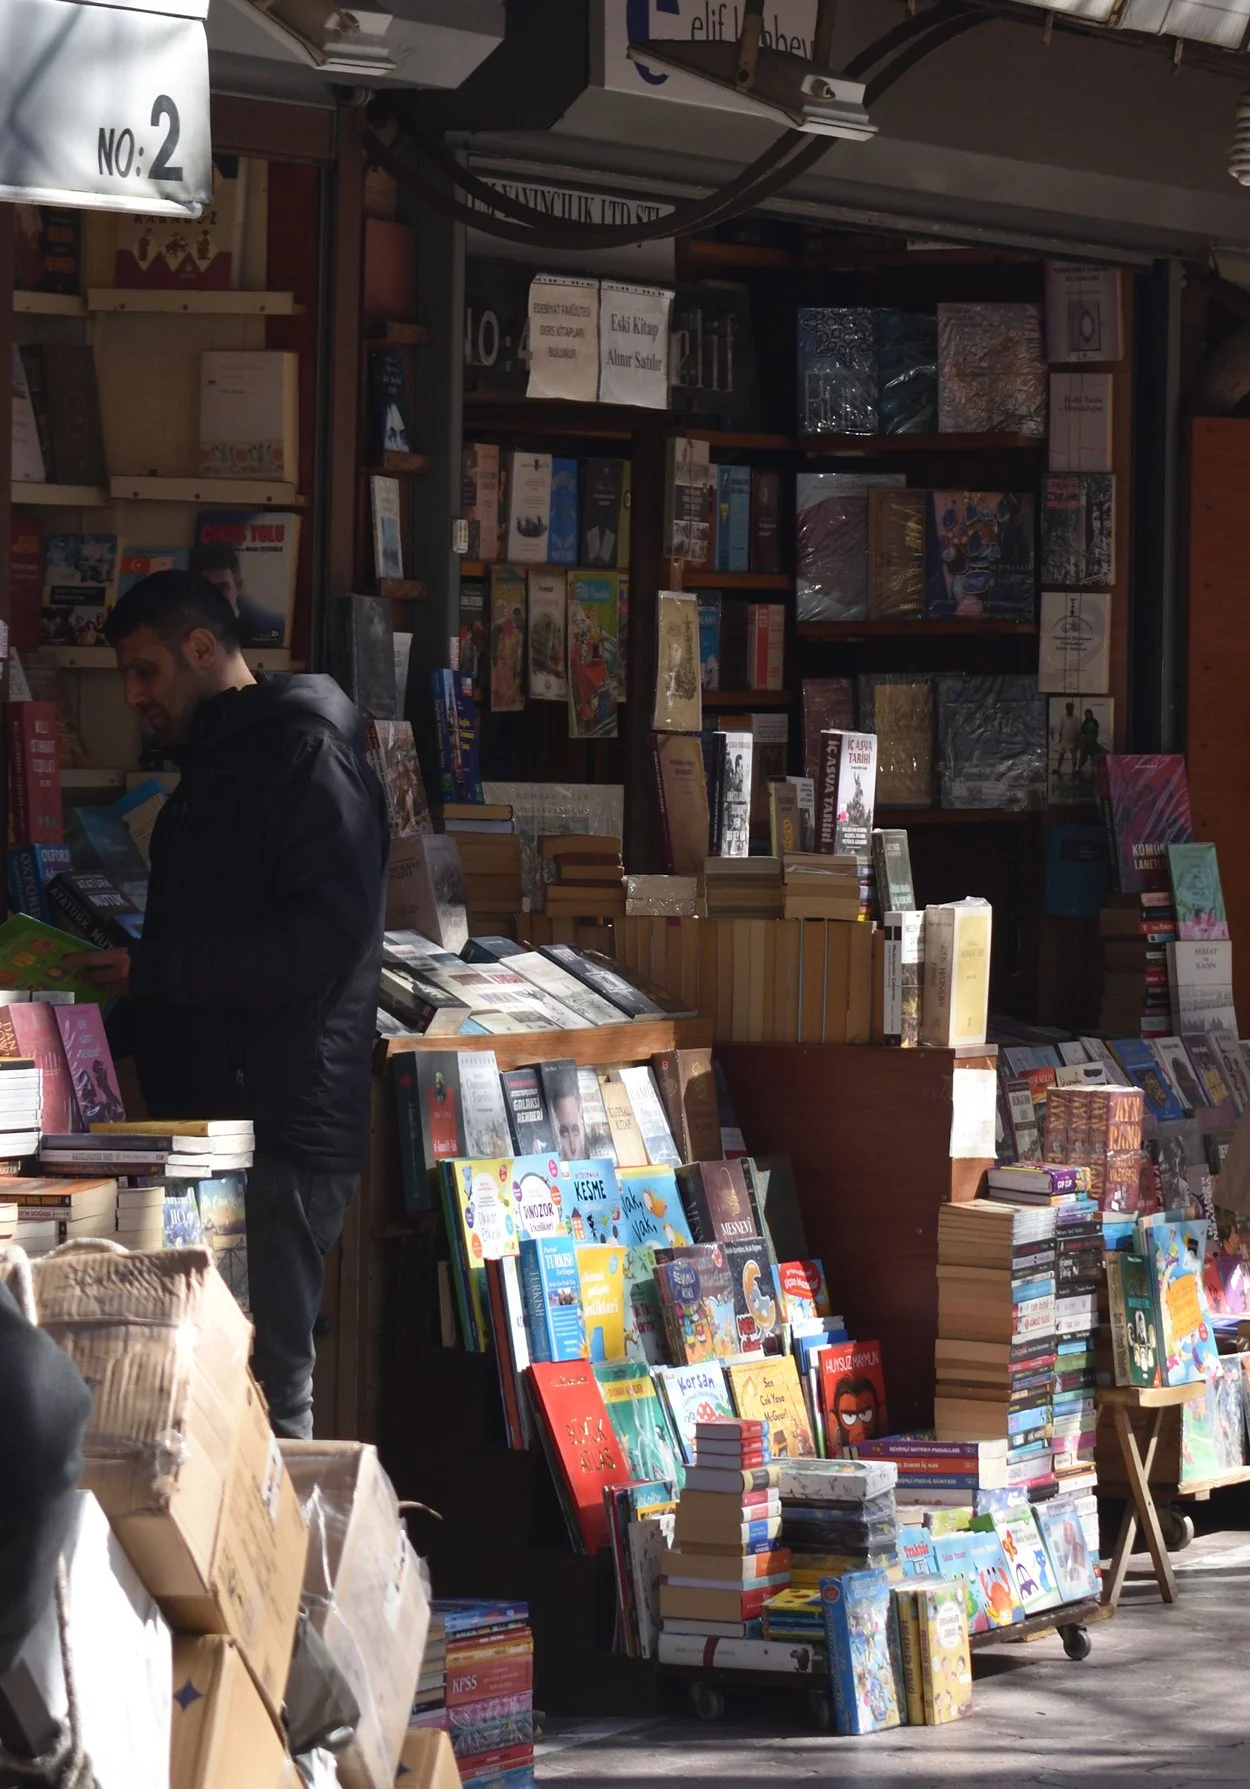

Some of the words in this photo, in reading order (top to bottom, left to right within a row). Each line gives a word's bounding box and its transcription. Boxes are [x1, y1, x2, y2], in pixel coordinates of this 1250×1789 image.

[692, 4, 727, 41] elif
[540, 326, 554, 337] DERS
[611, 314, 631, 333] Eski
[633, 316, 659, 338] Kitap
[607, 350, 632, 368] Alınır
[634, 352, 662, 372] Satılır
[250, 524, 285, 544] YOLU
[856, 738, 872, 751] ASYA
[825, 753, 840, 793] ASYA
[821, 796, 837, 844] TARİHİ
[90, 927, 113, 951] NUT
[574, 1179, 607, 1201] KESME
[720, 1217, 753, 1236] MESNEVİ
[825, 1355, 852, 1374] HUYSUZ
[851, 1351, 880, 1370] MAYMUN
[763, 1377, 775, 1388] Sen
[566, 1415, 608, 1445] BÜYÜK
[453, 1674, 478, 1693] KPSS
